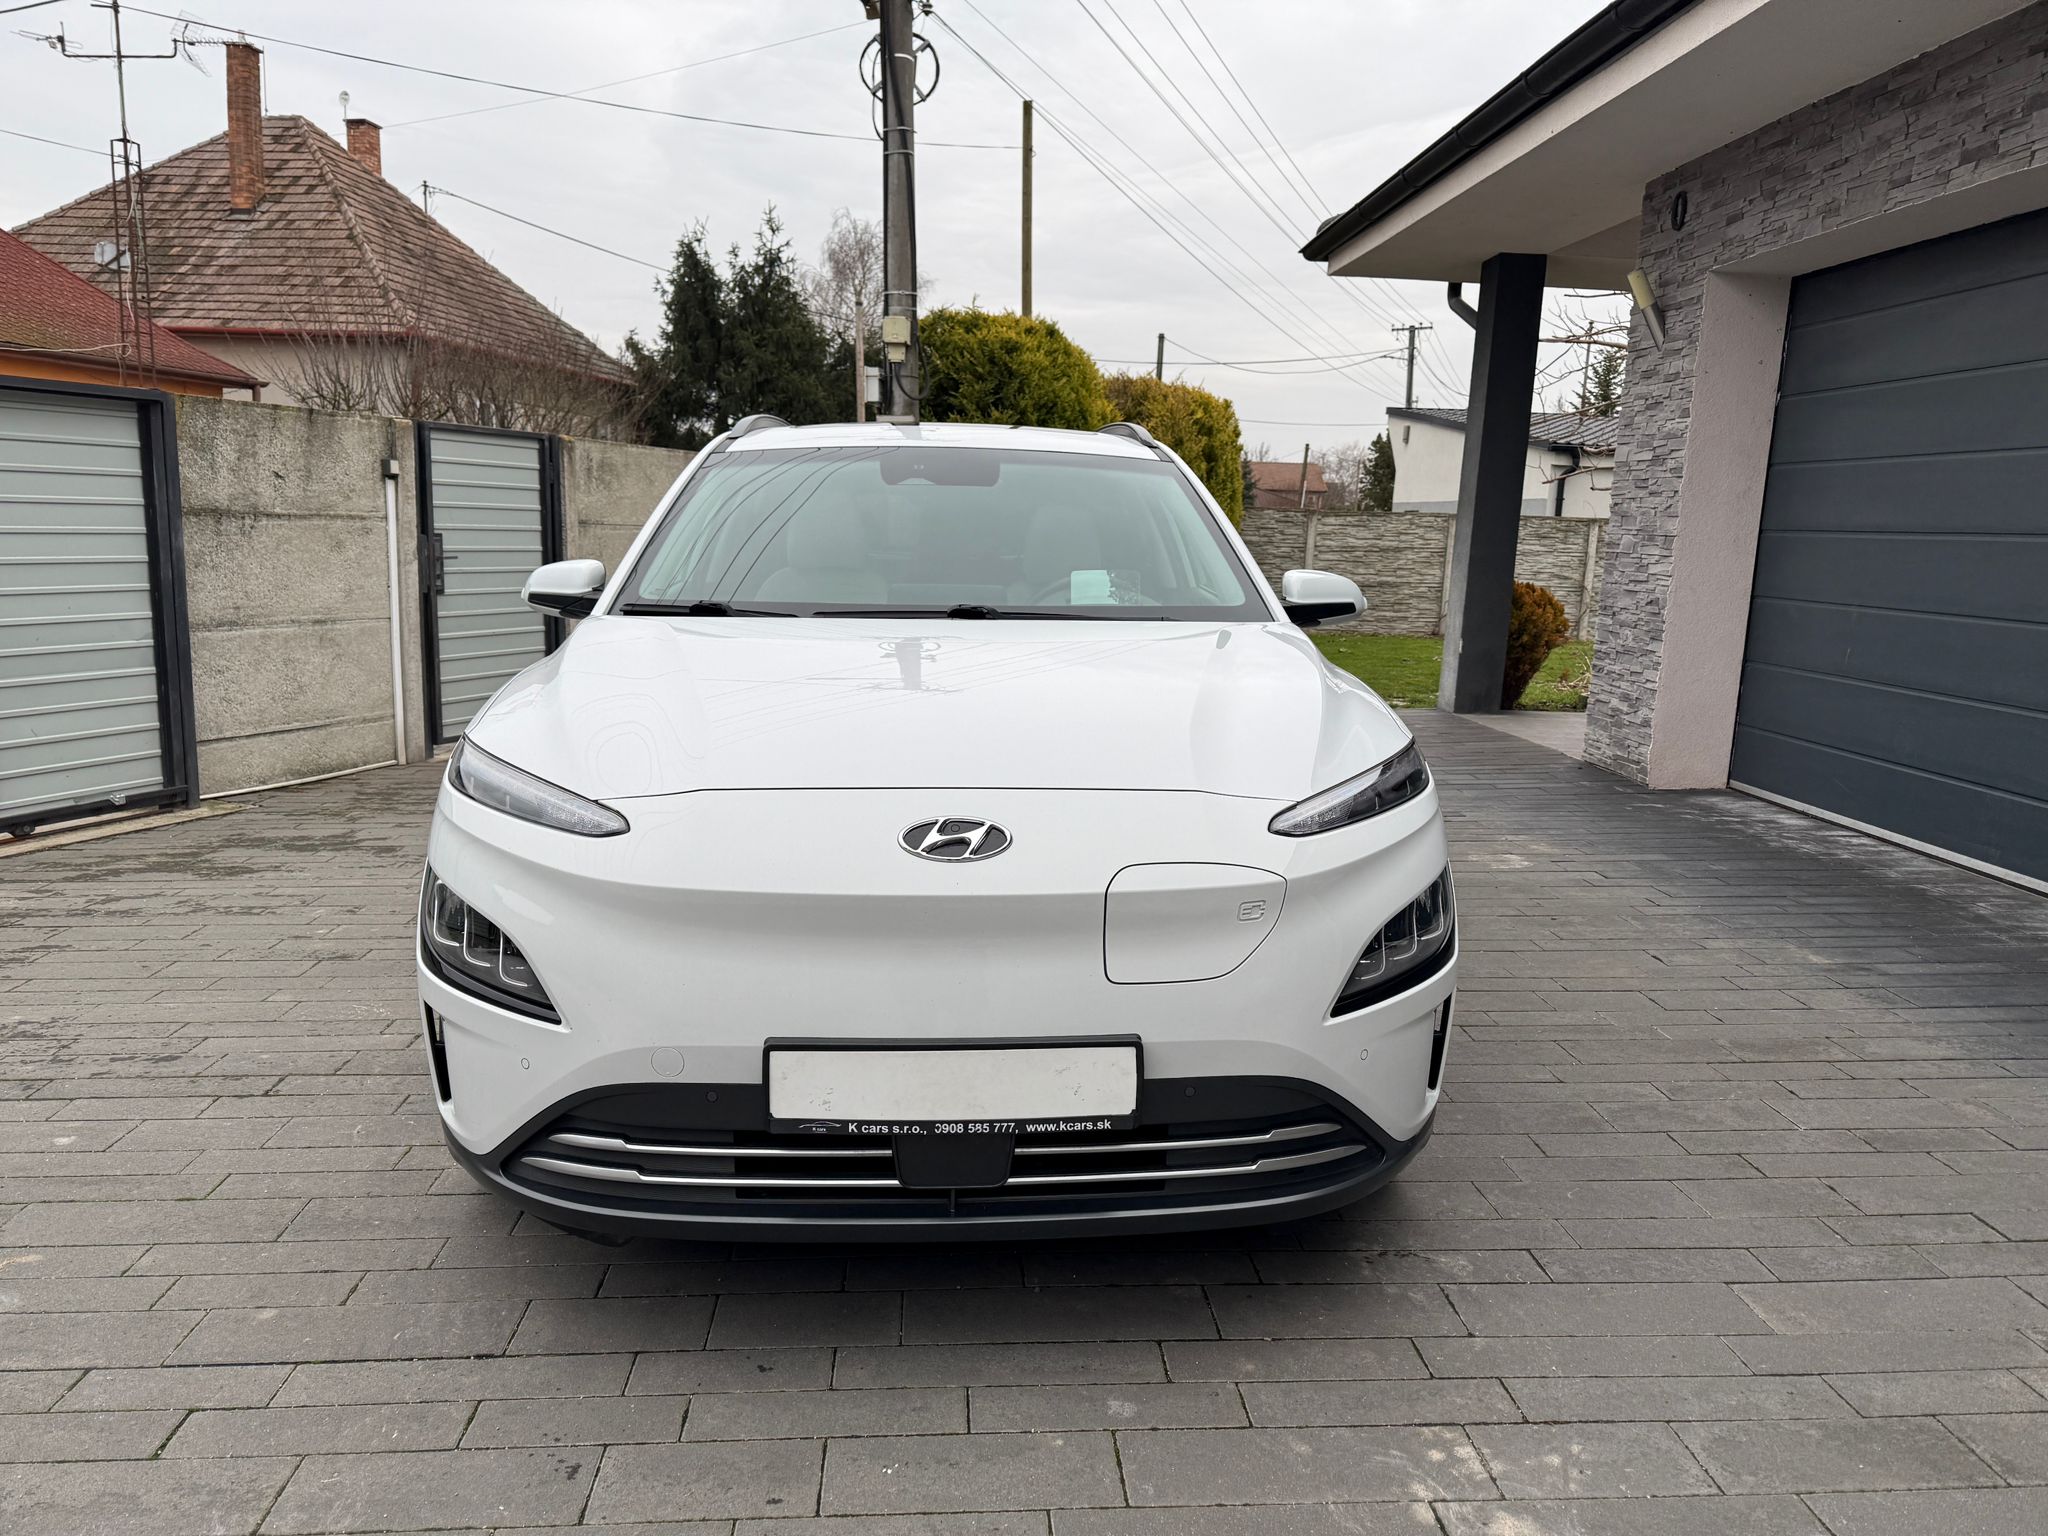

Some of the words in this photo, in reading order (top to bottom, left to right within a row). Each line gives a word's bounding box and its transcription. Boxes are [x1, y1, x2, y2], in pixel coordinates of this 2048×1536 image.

[848, 1122, 859, 1133] K
[861, 1124, 889, 1134] cars
[892, 1124, 928, 1135] s.r.o.,
[934, 1123, 964, 1134] 0908
[967, 1123, 990, 1134] 585
[993, 1122, 1019, 1134] 777,
[1025, 1119, 1112, 1133] www.kcars.sk
